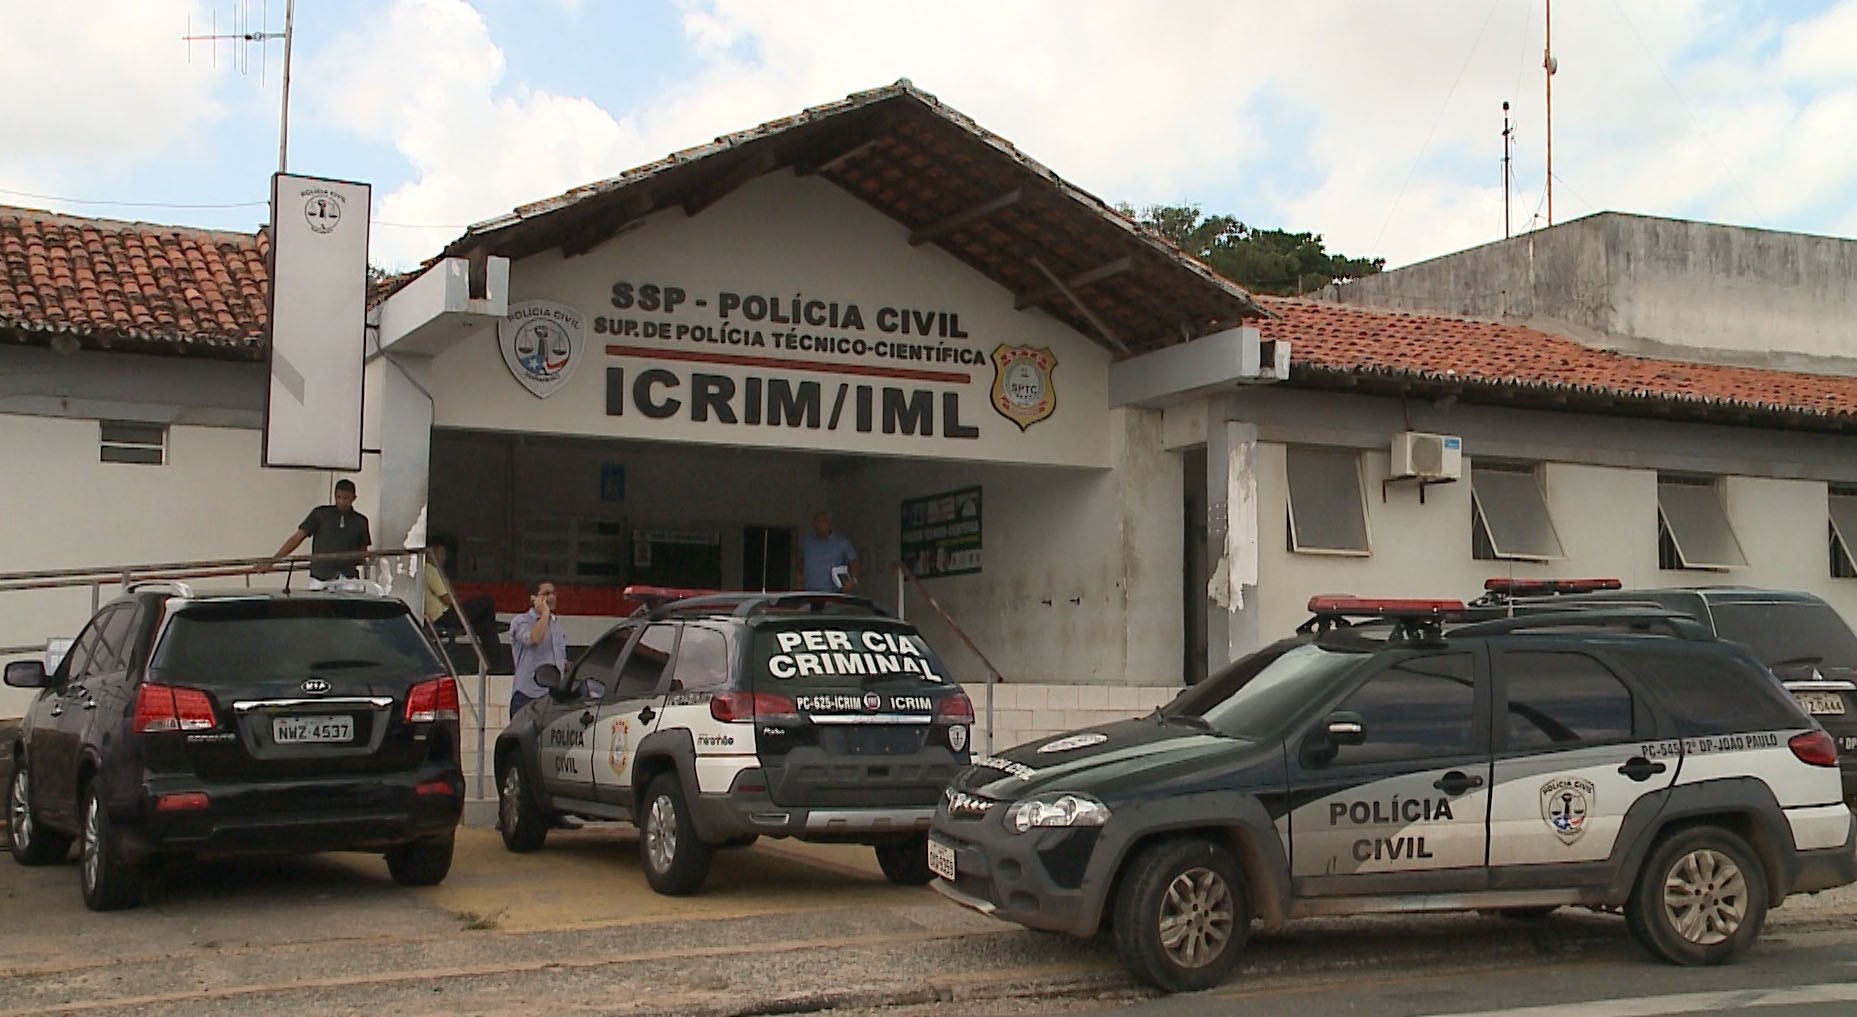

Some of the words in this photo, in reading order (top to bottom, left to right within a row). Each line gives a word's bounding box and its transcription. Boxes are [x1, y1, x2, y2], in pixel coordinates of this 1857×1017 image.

[553, 311, 580, 330] CIVIL
[611, 281, 687, 313] SSP
[719, 291, 865, 330] POLÍCIA
[876, 307, 969, 339] CIVIL
[594, 316, 640, 337] SUP.
[643, 321, 672, 339] DE
[676, 321, 765, 348] POLÍCIA
[772, 328, 986, 366] TÉCNICO-CIENTÍFICA
[605, 366, 980, 439] ICRIM/IML
[768, 653, 943, 683] CRIMINAL
[890, 697, 932, 710] ICRIM
[550, 724, 585, 748] POLÍCIA
[1746, 733, 1778, 748] PAULO
[555, 756, 578, 774] CIVIL
[1329, 793, 1454, 826] POLÍCIA
[1352, 836, 1434, 862] CIVIL
